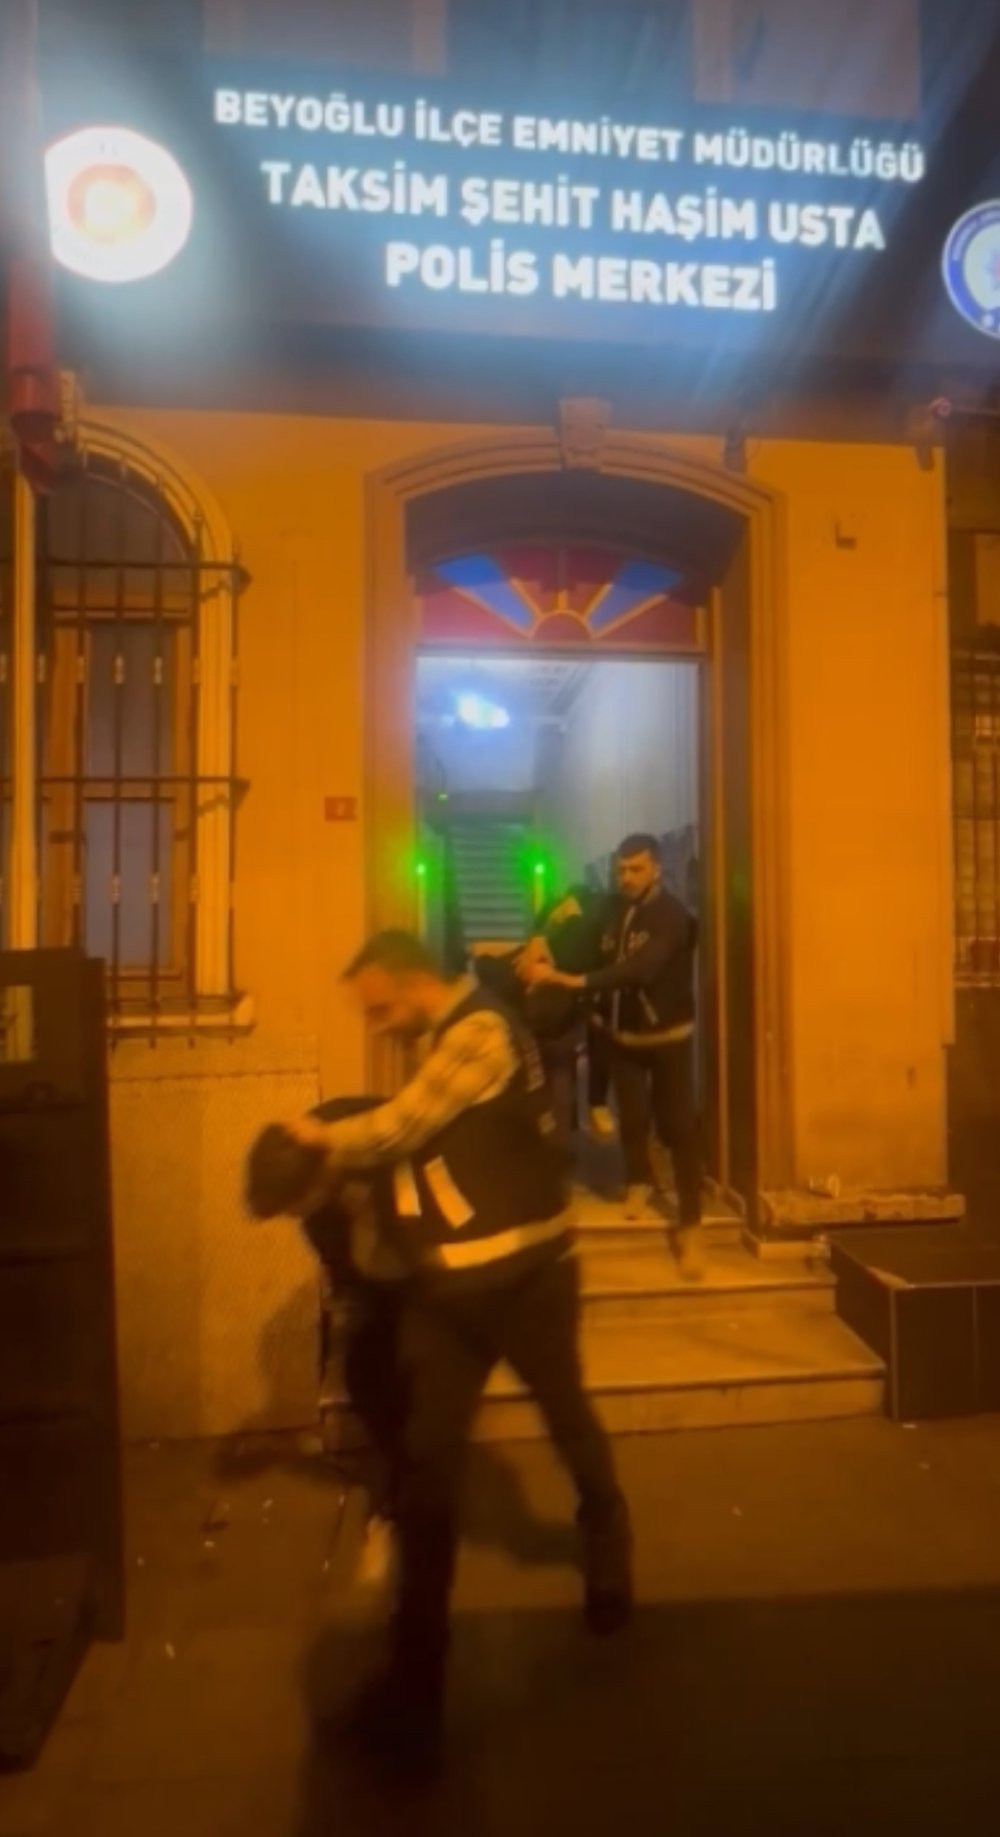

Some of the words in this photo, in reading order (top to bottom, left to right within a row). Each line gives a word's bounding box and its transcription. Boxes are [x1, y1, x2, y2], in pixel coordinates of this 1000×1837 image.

[213, 89, 404, 138] BEYOĞLU
[415, 99, 502, 147] İLÇE
[513, 115, 683, 161] EMNİYET
[694, 127, 925, 182] MÜDÜRLÜĞÜ
[261, 160, 447, 216] TAKSİM
[461, 174, 598, 229] ŞEHİT
[611, 186, 758, 241] HAŞİM
[768, 203, 885, 250] USTA
[386, 238, 538, 295] POLİS
[552, 252, 776, 311] MERKEZİ
